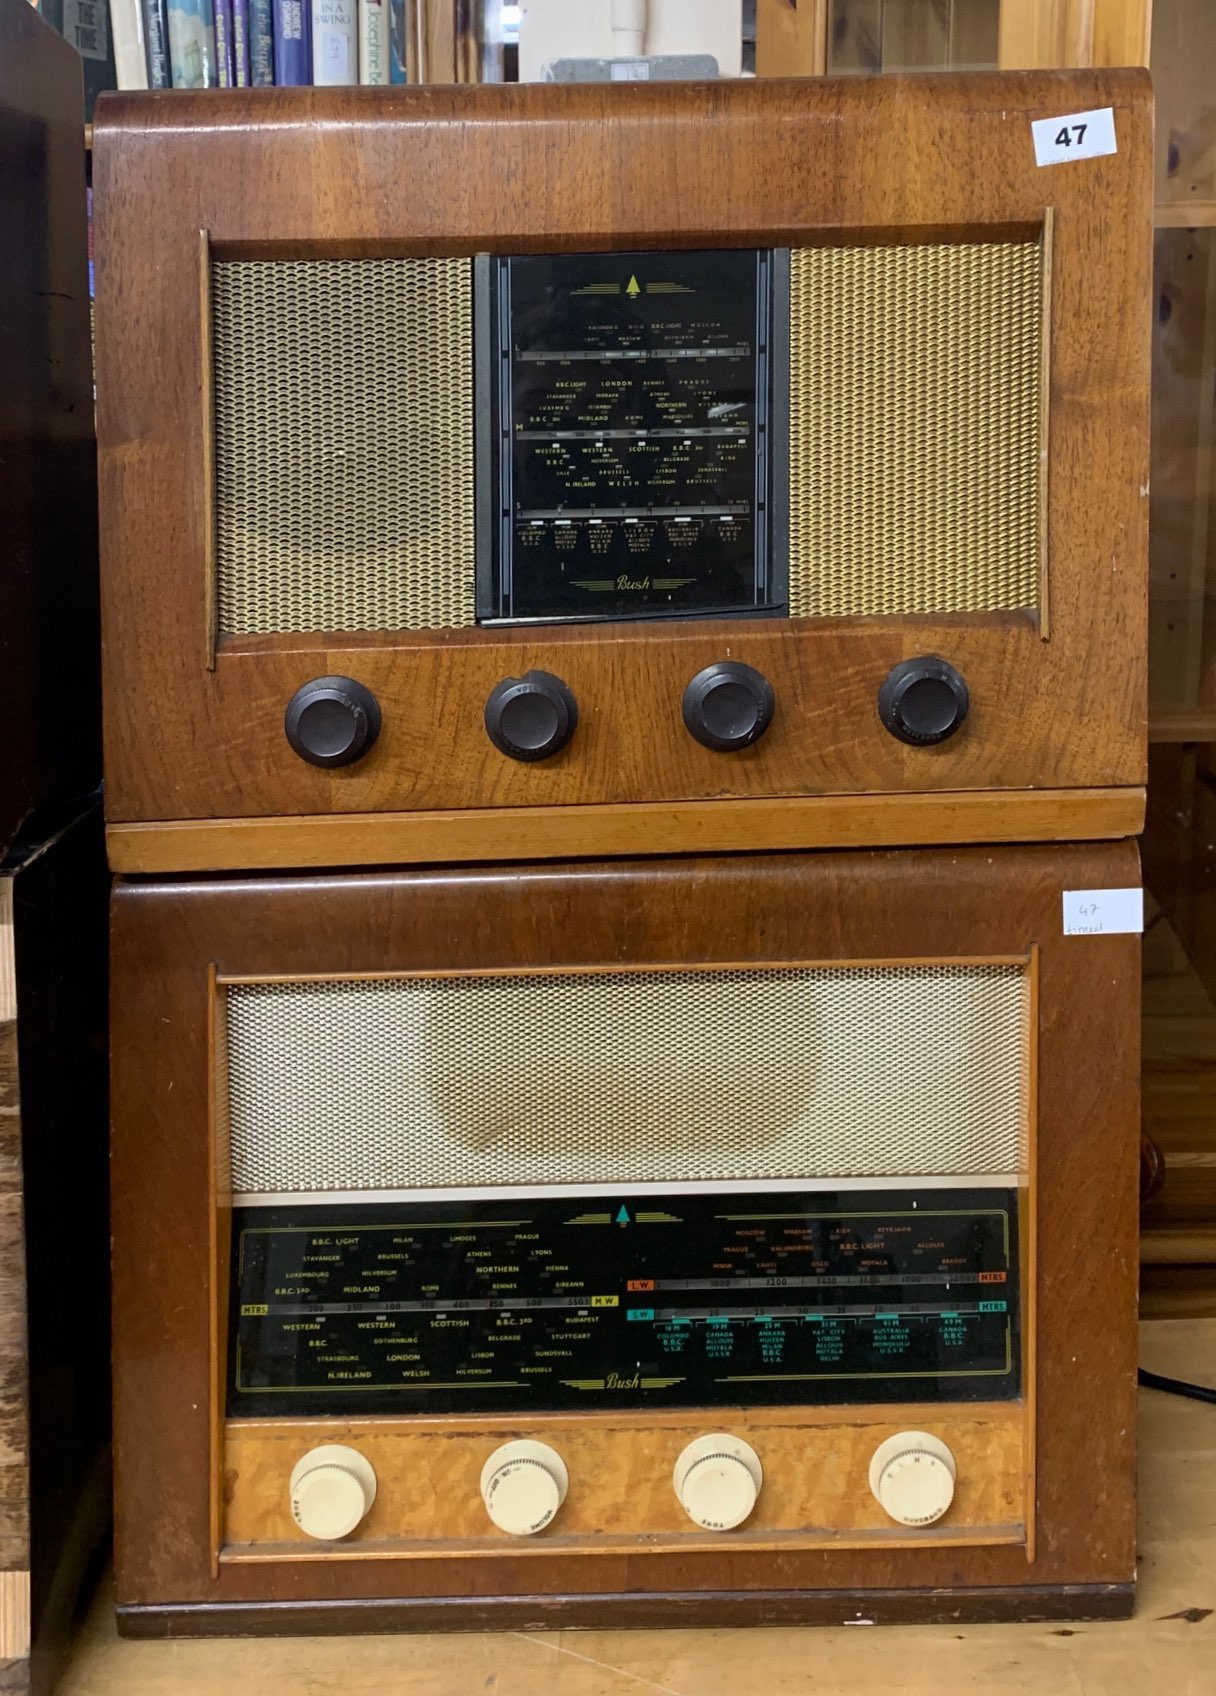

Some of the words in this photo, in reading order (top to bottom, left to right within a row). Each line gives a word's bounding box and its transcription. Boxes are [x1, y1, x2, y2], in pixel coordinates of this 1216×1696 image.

[78, 2, 95, 26] THE
[321, 3, 332, 13] IN
[333, 3, 343, 13] A
[291, 1, 302, 39] ANDREW
[315, 15, 351, 24] SWING
[75, 25, 97, 50] TIME
[367, 9, 380, 69] Josephine
[1054, 123, 1088, 147] 47
[616, 574, 650, 590] Bush
[1078, 903, 1101, 917] 47
[335, 1237, 360, 1246] LIGHT
[766, 1278, 787, 1286] 1200
[981, 1273, 1003, 1281] MTRS
[526, 1299, 542, 1307] 500
[982, 1303, 1004, 1311] MTRS
[243, 1306, 267, 1314] MTRS
[282, 1323, 321, 1331] WESTERN
[606, 1372, 640, 1390] Bush
[530, 1509, 553, 1531] VOLUME
